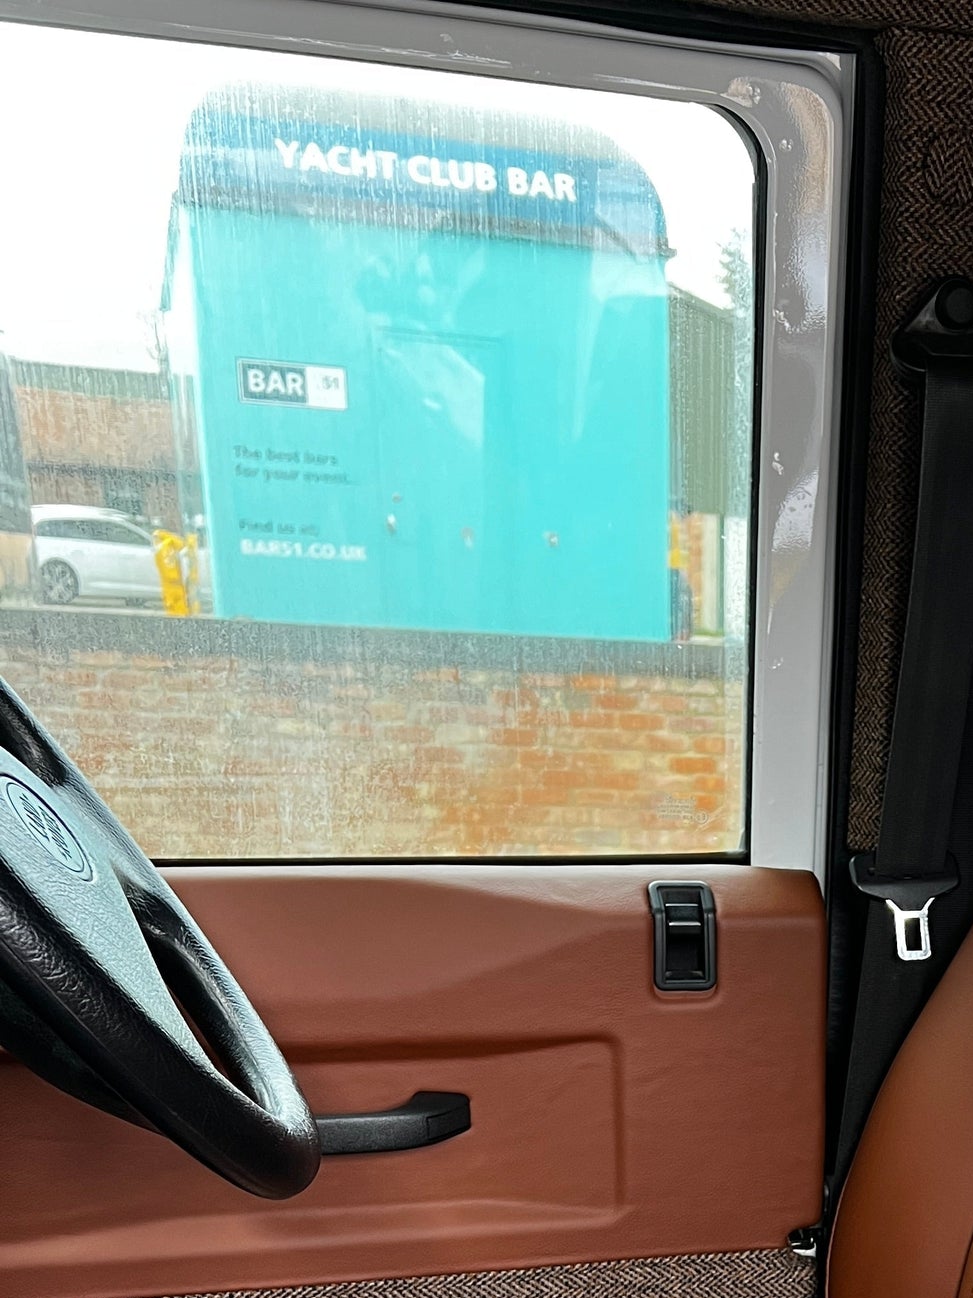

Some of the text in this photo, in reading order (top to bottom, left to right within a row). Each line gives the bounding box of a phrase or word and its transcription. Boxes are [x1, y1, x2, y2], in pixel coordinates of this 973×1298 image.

[274, 137, 578, 203] YACHT CLUB BAR
[247, 368, 305, 397] BAR
